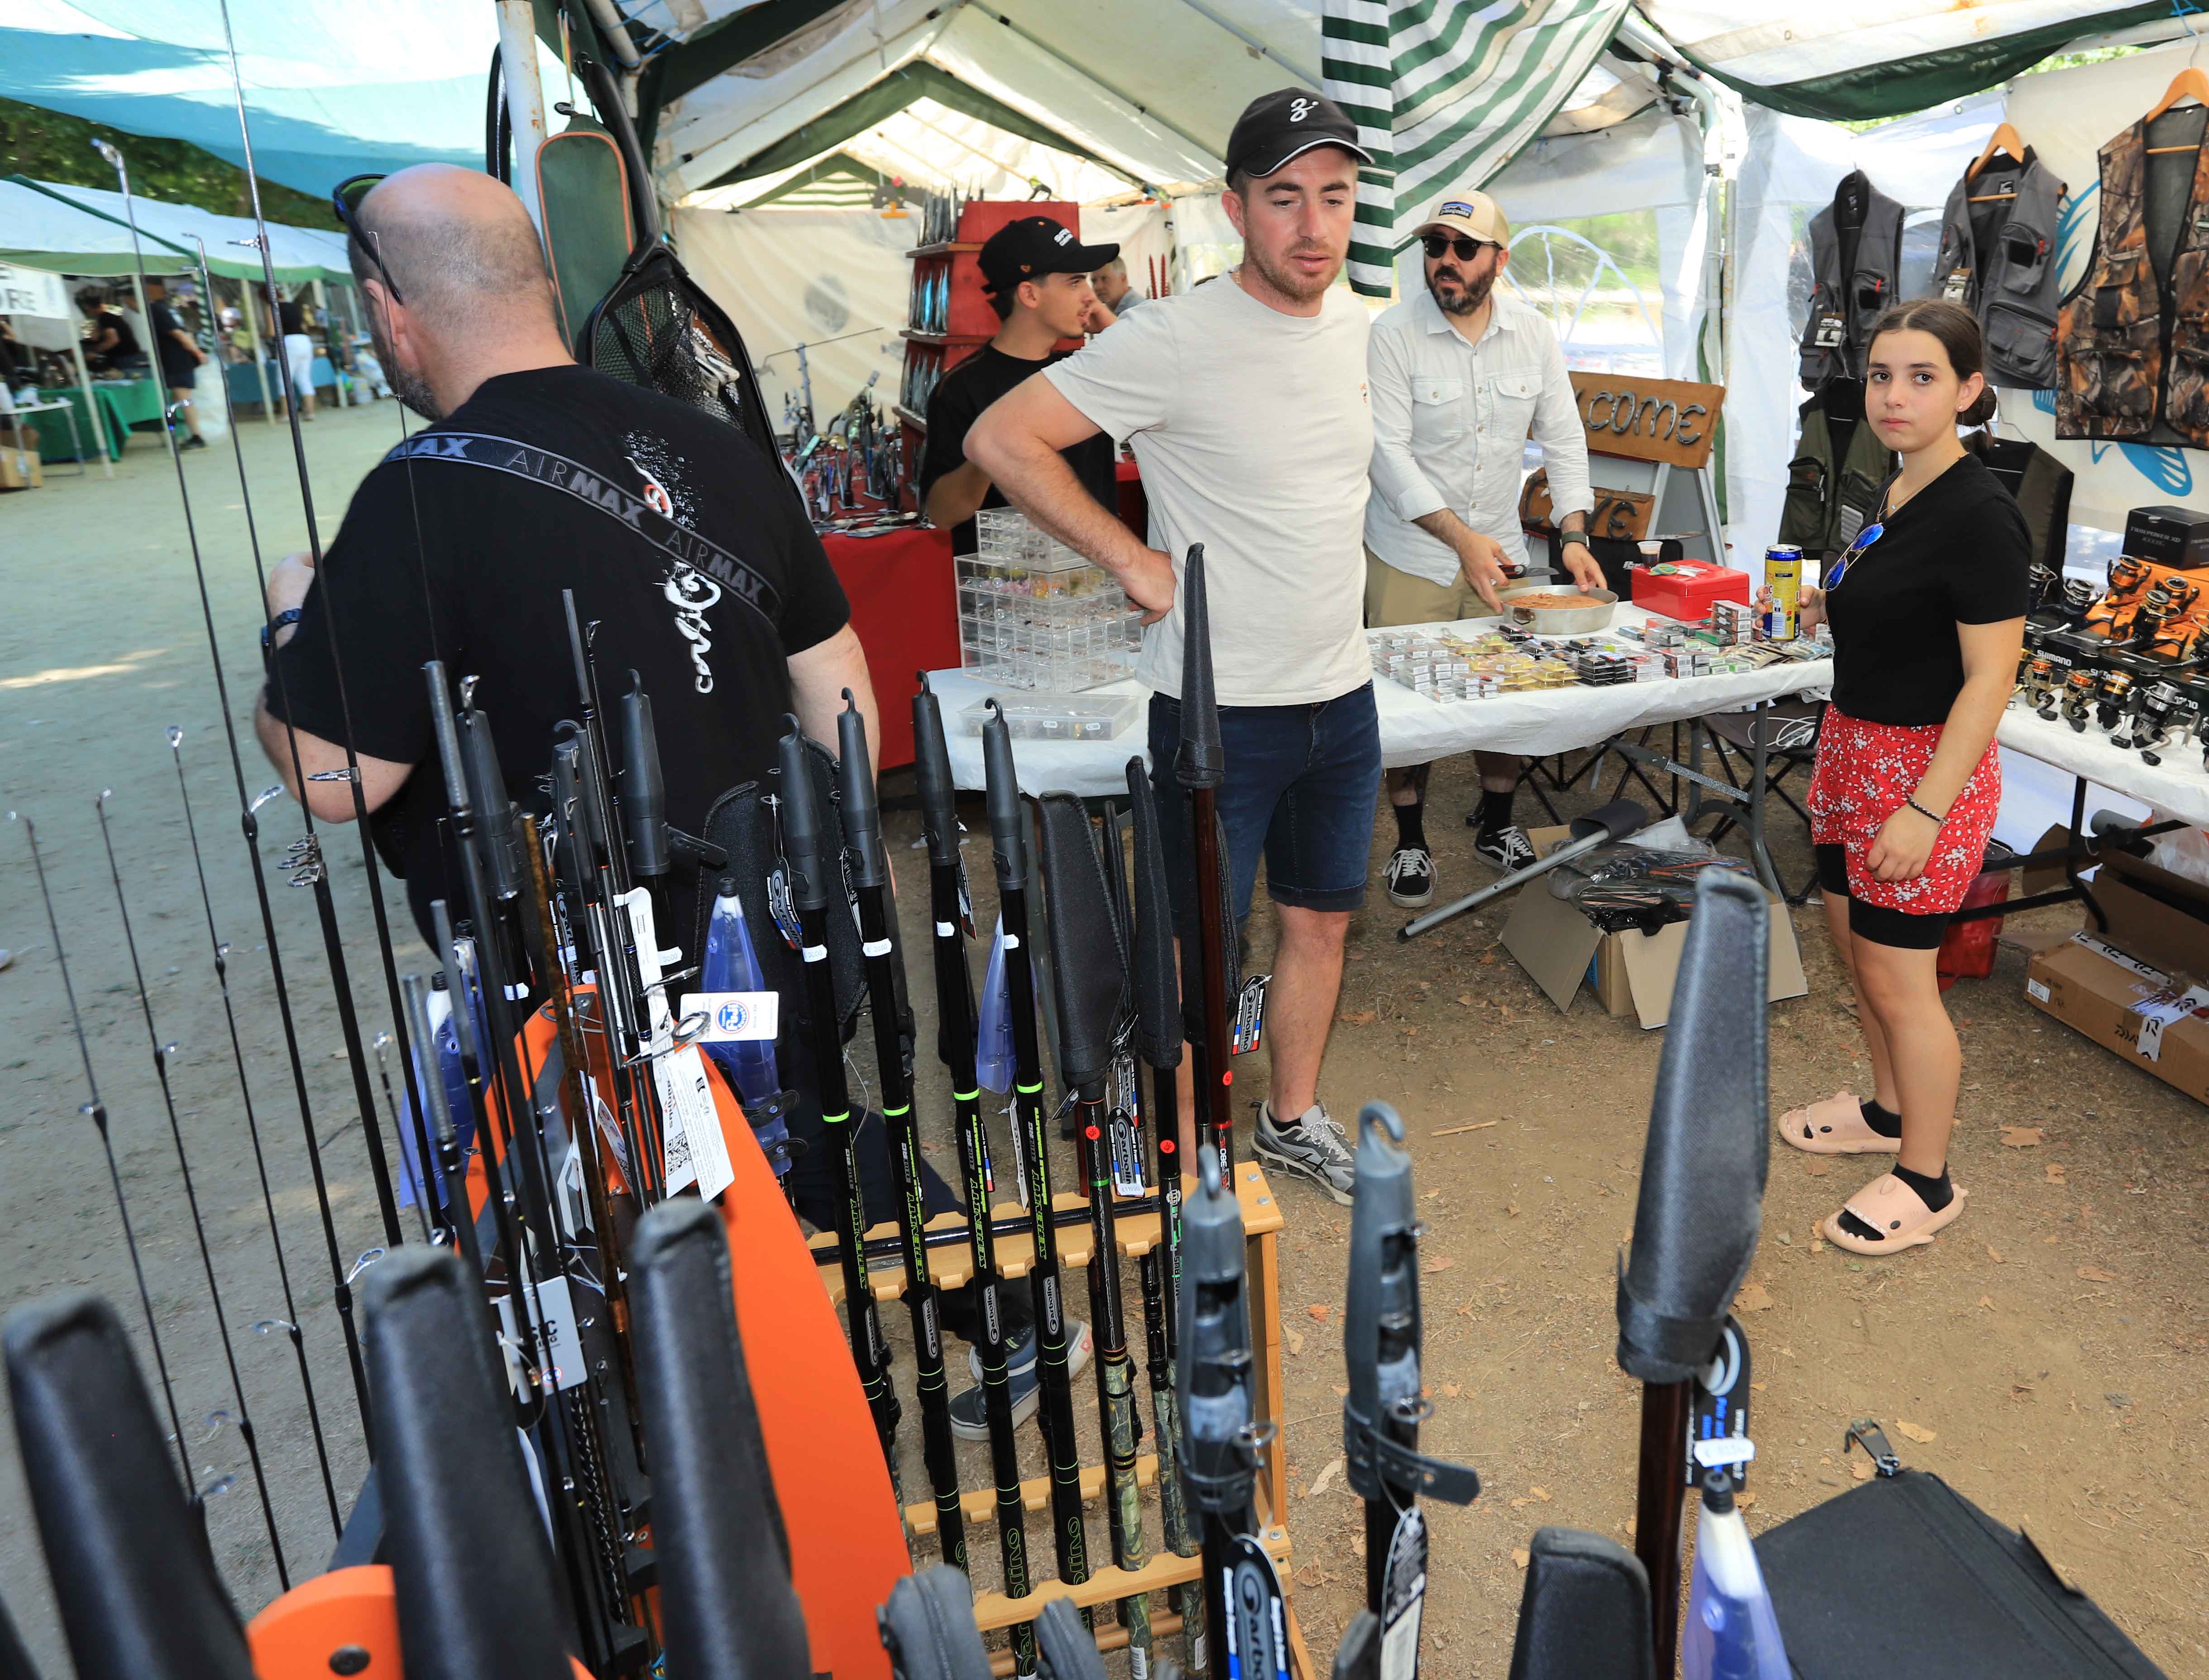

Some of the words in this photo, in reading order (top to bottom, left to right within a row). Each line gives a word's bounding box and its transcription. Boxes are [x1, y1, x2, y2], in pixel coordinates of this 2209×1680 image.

[0, 288, 37, 311] RE
[505, 449, 646, 529] AIRMAX
[666, 529, 765, 604] AIRMAX
[2037, 649, 2072, 667] SHIMANO
[726, 1003, 739, 1031] Fuji
[1243, 988, 1256, 1050] Garbolino
[1117, 1122, 1132, 1184] Garbolin
[850, 1198, 868, 1289] SERENITY
[907, 1191, 925, 1282] SERENITY
[970, 1177, 987, 1269] SERENITY
[1032, 1169, 1047, 1260] SERENITY
[926, 1300, 937, 1355] Garbolino
[985, 1288, 999, 1341] Garbolino
[1046, 1279, 1058, 1332] Garbolino
